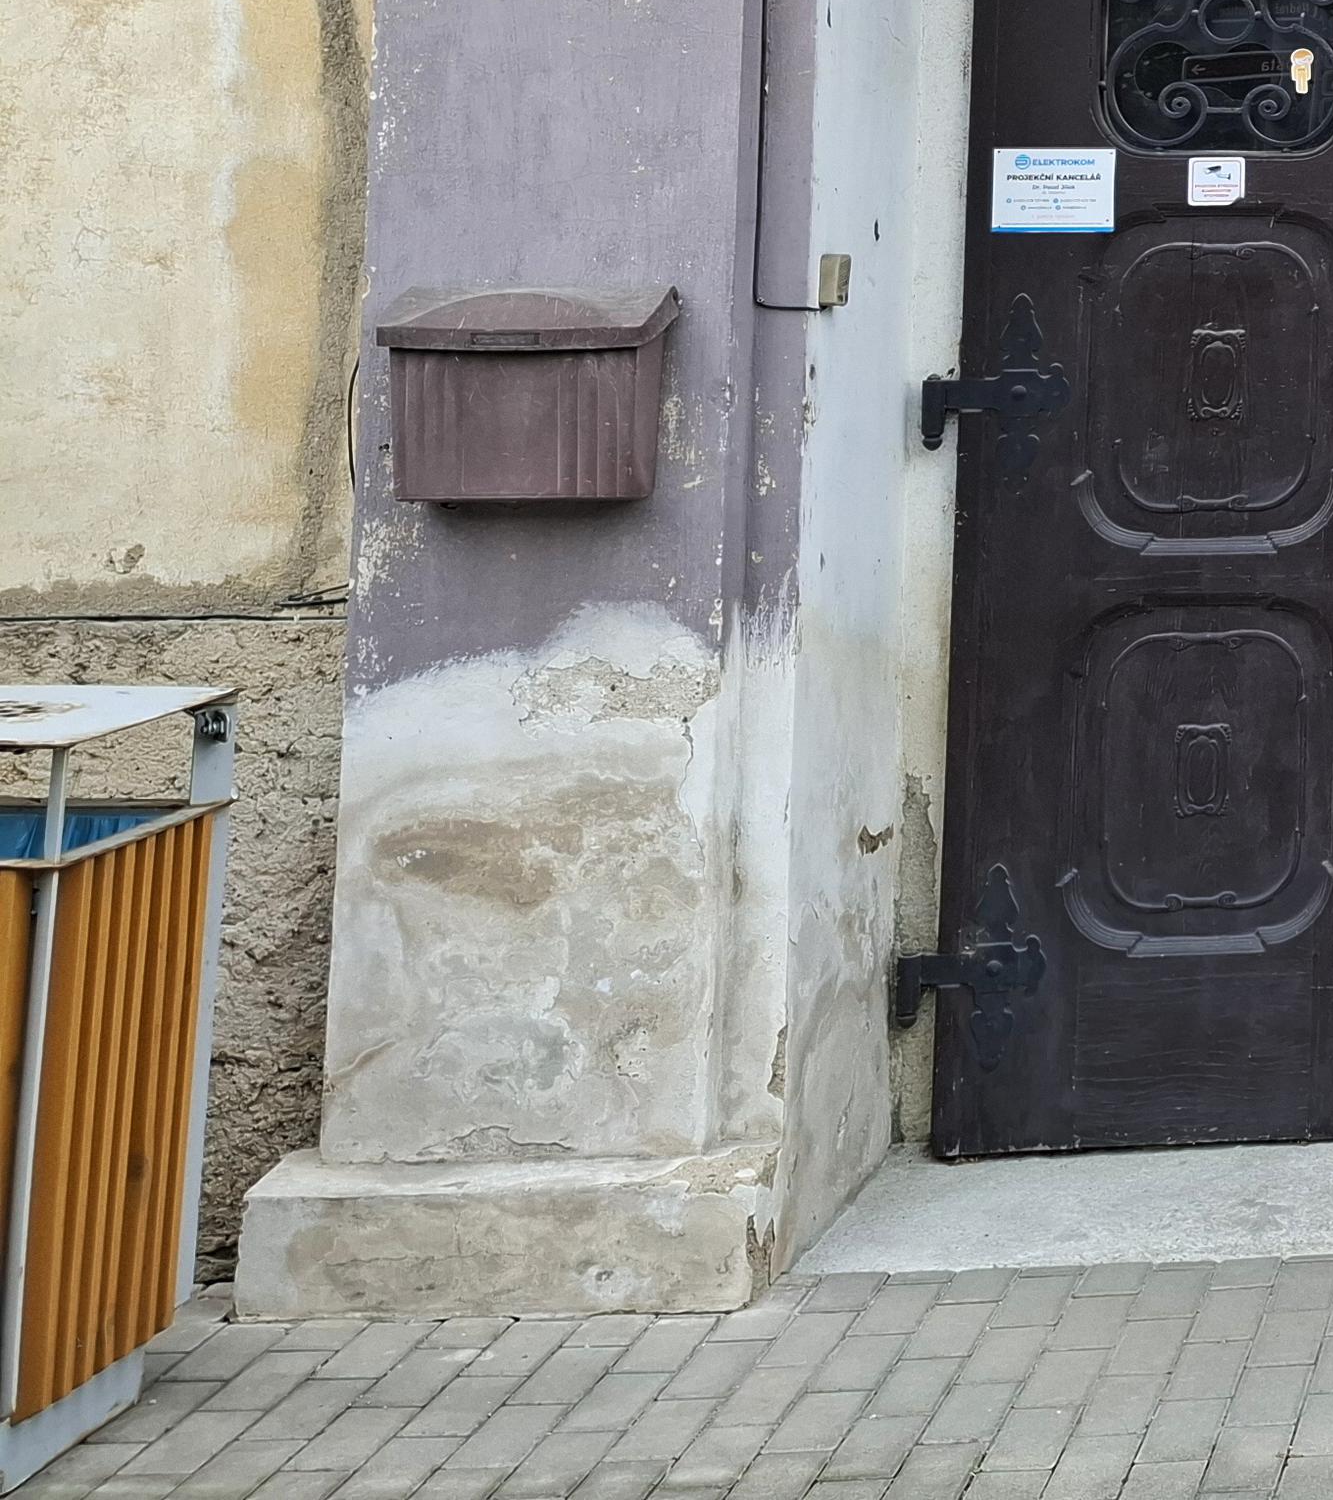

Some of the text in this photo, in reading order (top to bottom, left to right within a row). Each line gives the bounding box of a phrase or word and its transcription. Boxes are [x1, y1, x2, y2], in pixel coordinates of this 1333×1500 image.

[1032, 158, 1095, 166] ELEKTROKOM
[1007, 172, 1102, 181] PROJEKČNÍ KANCELÁŘ
